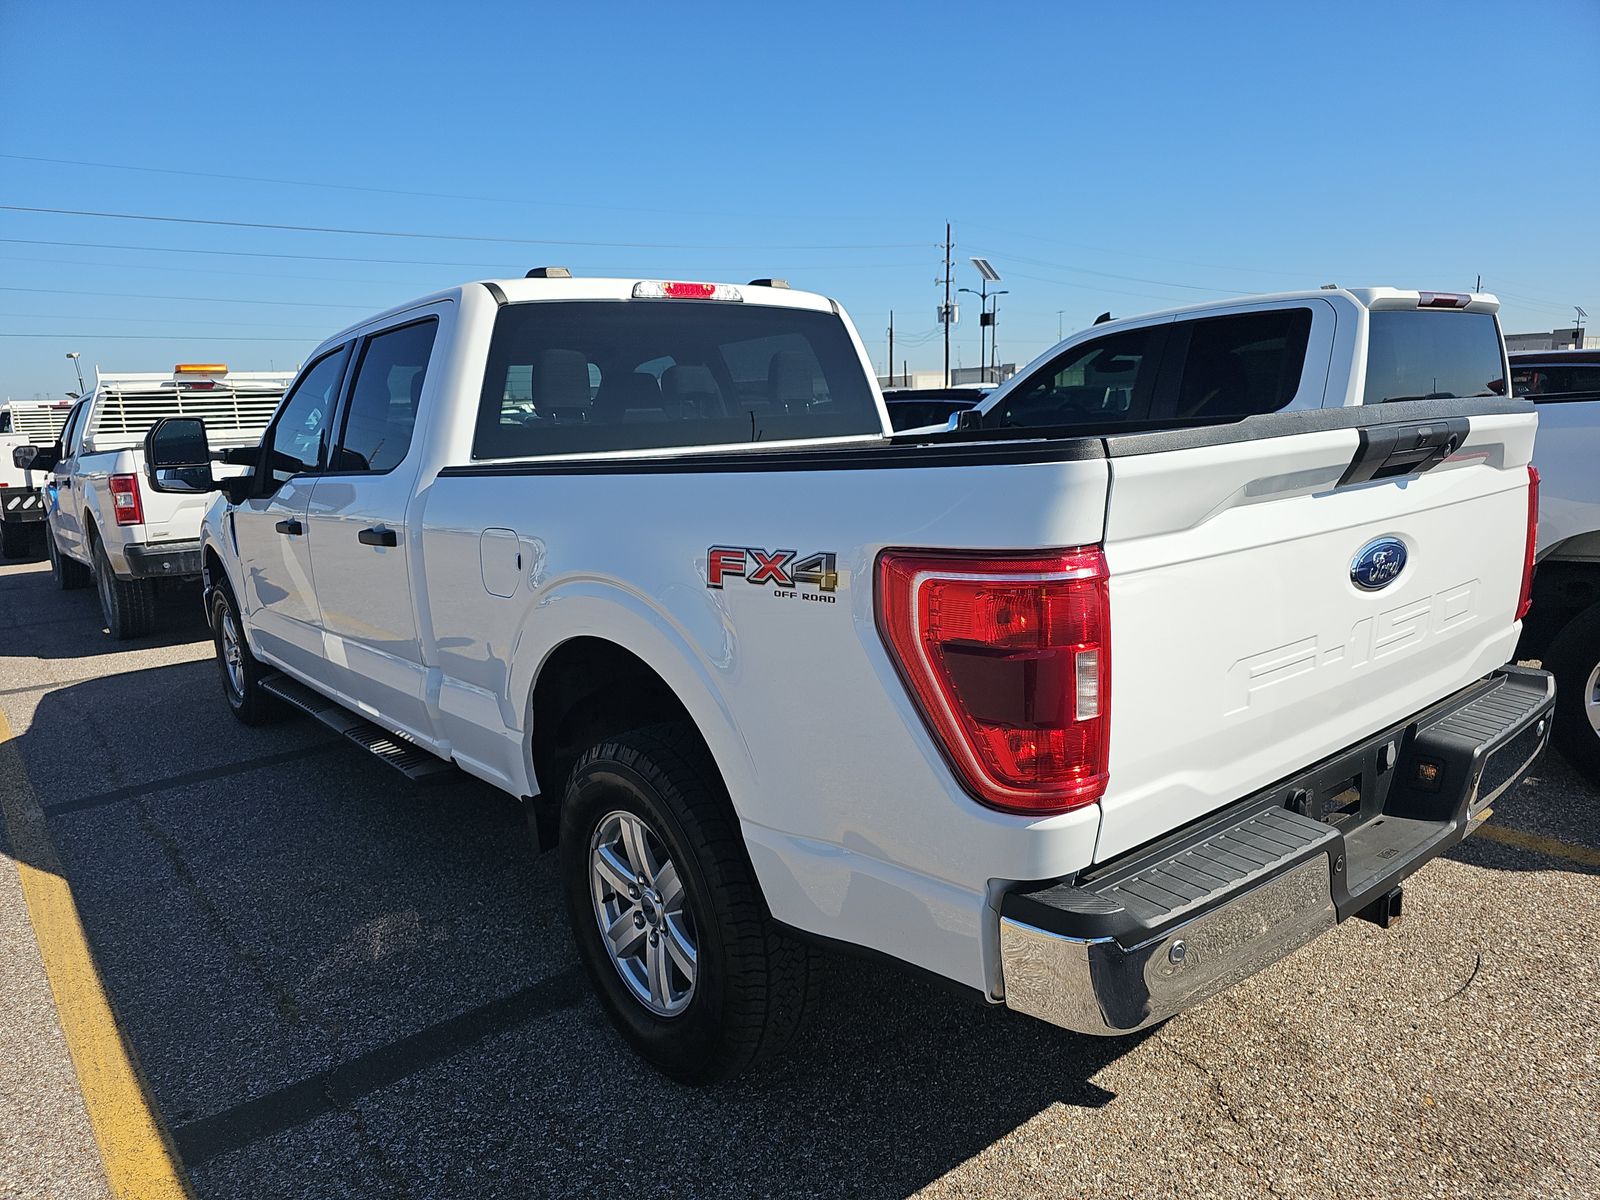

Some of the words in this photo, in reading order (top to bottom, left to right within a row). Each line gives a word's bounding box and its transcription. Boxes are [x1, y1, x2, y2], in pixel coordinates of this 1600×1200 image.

[706, 544, 838, 592] FX4
[1369, 549, 1400, 582] Ford
[773, 589, 798, 599] OFF
[801, 592, 836, 604] ROAD
[1223, 577, 1482, 718] F-150
